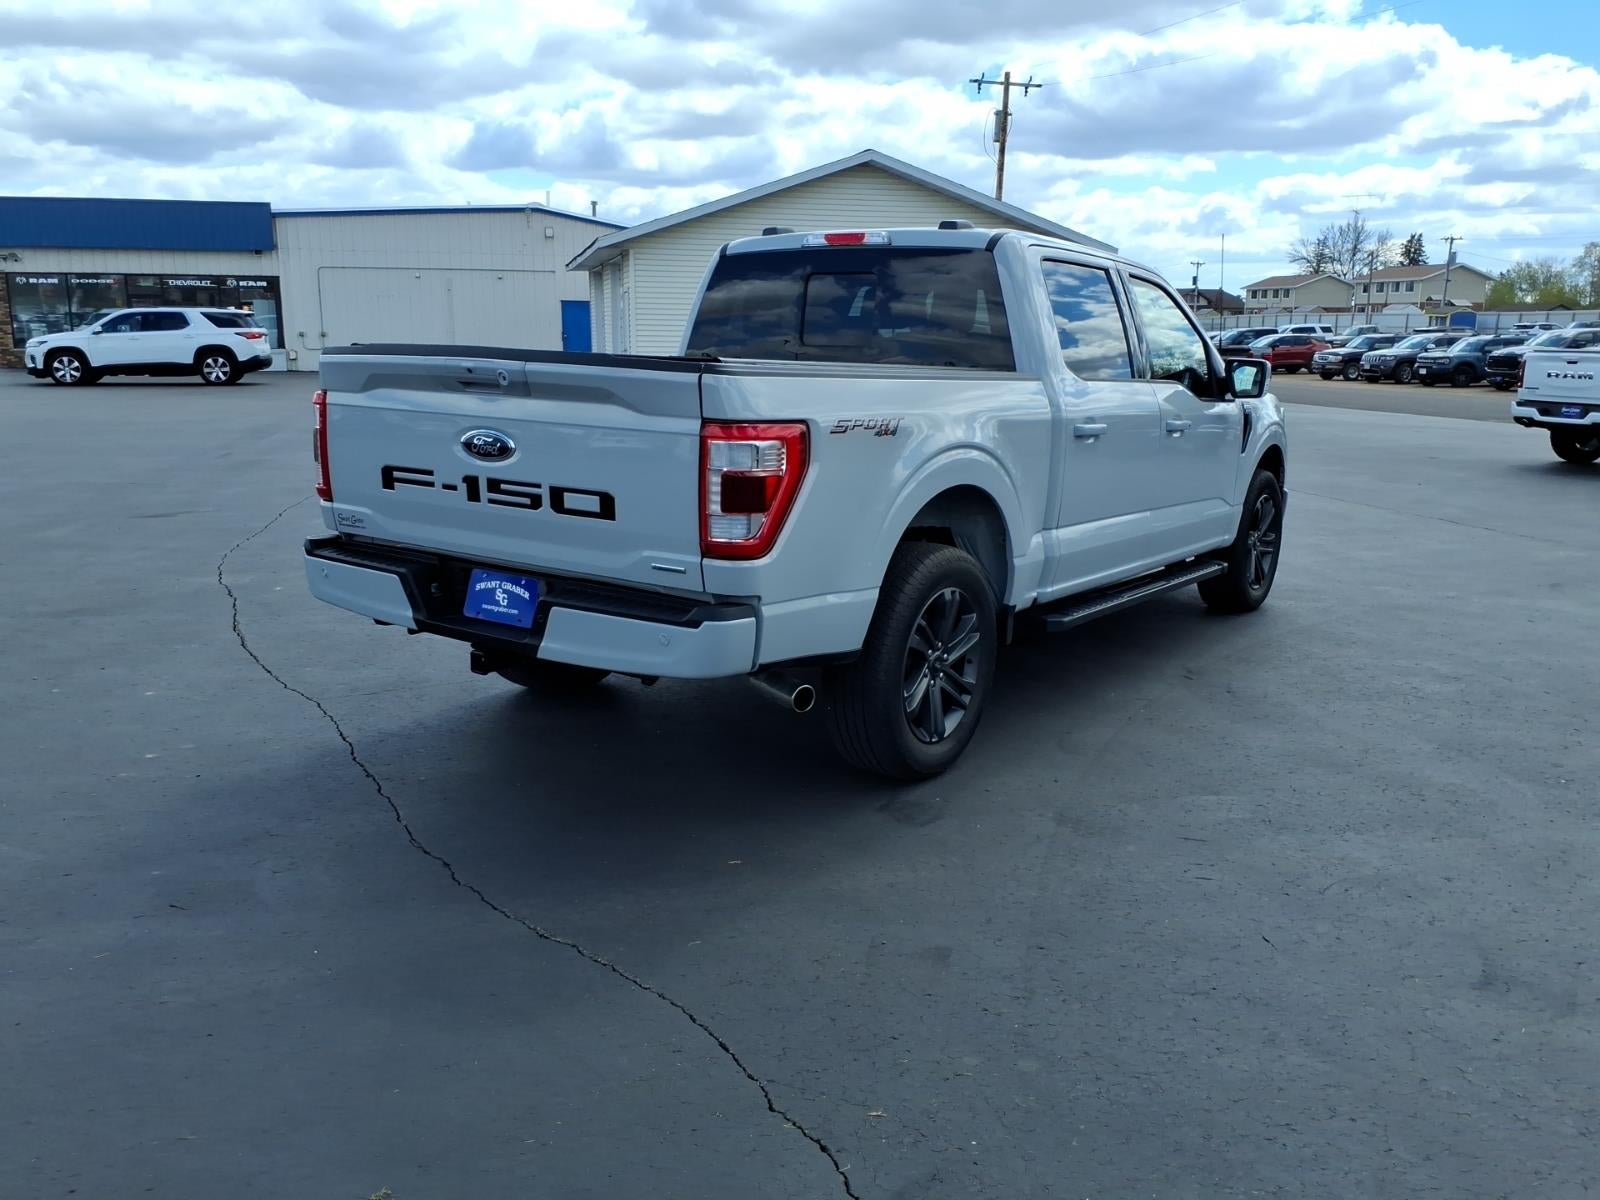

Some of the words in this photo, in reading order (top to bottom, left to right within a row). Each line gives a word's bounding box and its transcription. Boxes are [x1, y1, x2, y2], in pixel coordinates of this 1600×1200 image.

[1547, 371, 1594, 380] RAM
[830, 417, 904, 435] SPORT
[471, 436, 500, 454] Ford
[381, 464, 616, 522] F-150
[475, 581, 501, 591] SWANT
[502, 581, 530, 600] GRABER
